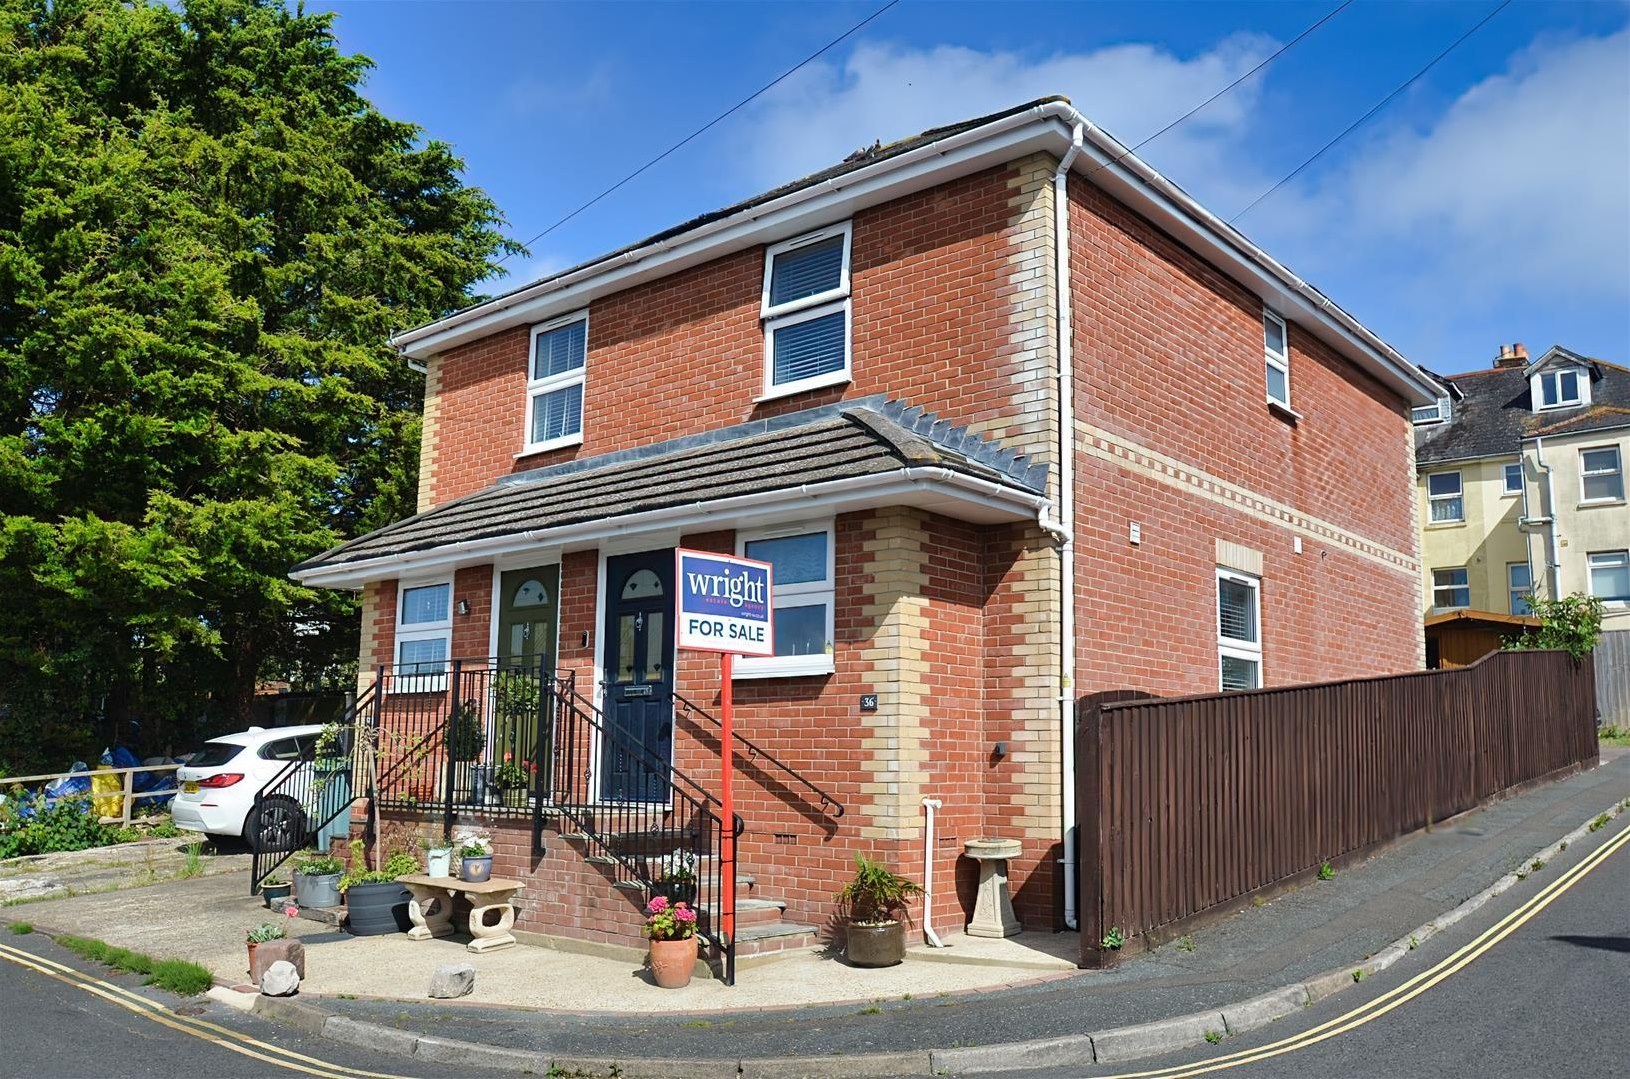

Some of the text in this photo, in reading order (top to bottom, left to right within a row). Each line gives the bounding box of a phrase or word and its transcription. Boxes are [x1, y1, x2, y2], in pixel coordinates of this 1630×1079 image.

[687, 568, 764, 607] wright
[689, 619, 764, 642] FOR SALE
[864, 697, 875, 707] 36
